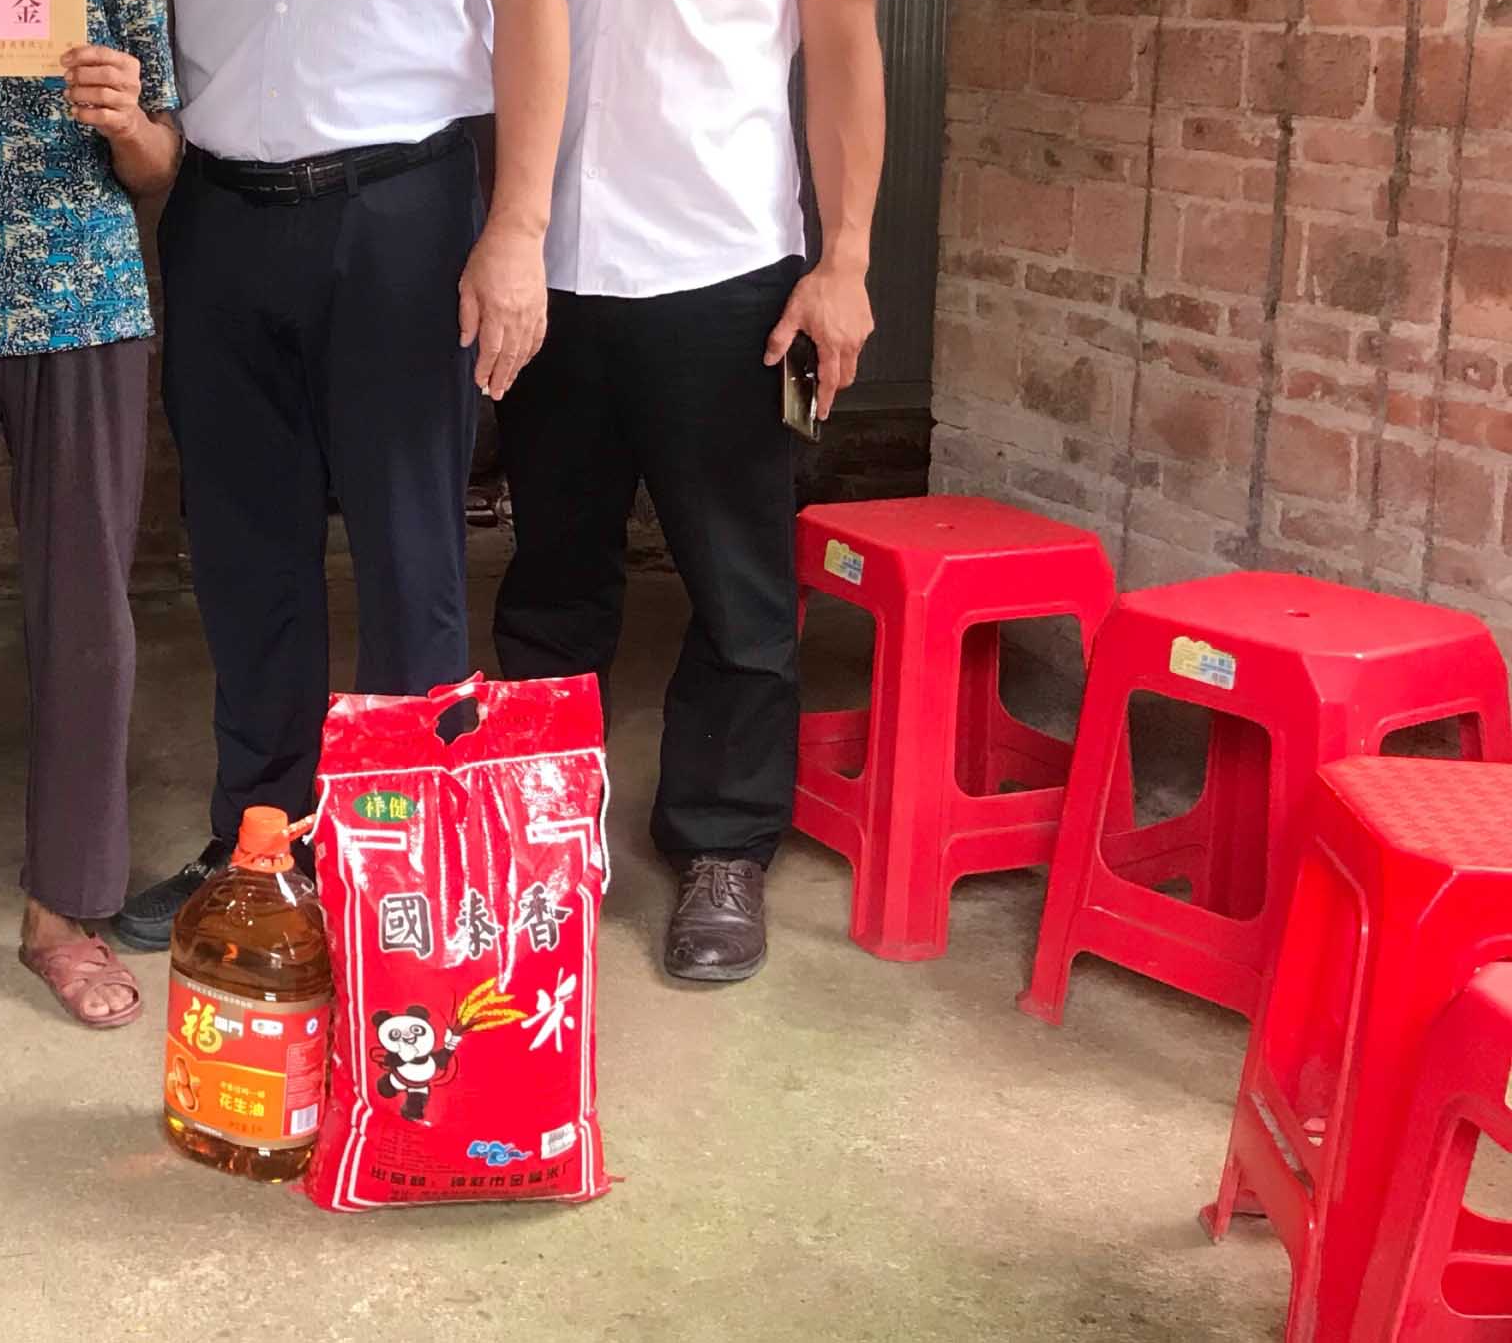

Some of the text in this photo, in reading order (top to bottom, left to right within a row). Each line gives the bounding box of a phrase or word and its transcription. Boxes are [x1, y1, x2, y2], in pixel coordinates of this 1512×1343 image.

[521, 966, 577, 1053] 米
[219, 1091, 265, 1117] 花生油
